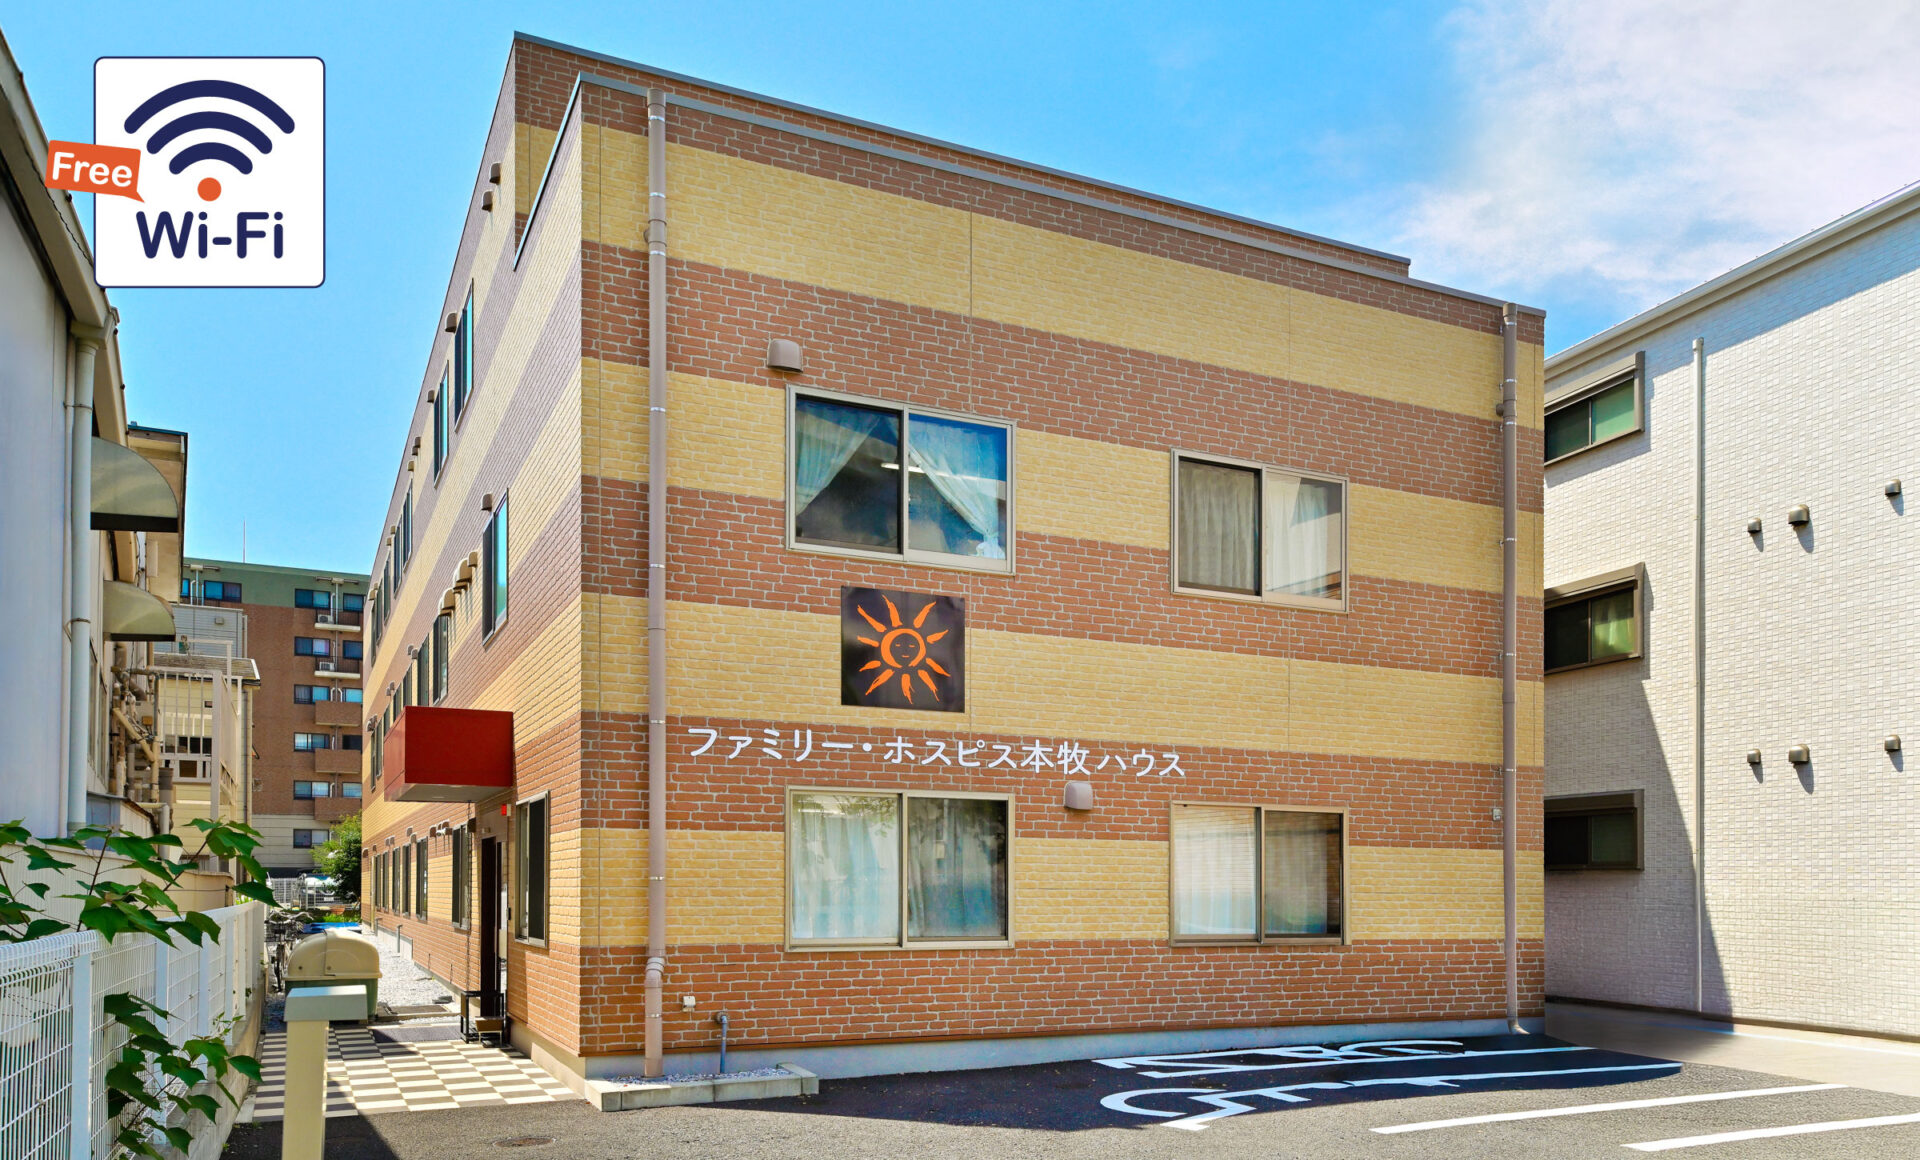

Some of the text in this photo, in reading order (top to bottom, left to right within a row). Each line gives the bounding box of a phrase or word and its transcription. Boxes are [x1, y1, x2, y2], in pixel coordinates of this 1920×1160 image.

[688, 728, 1185, 777] ファミリー・ホスピス本牧ハウス
